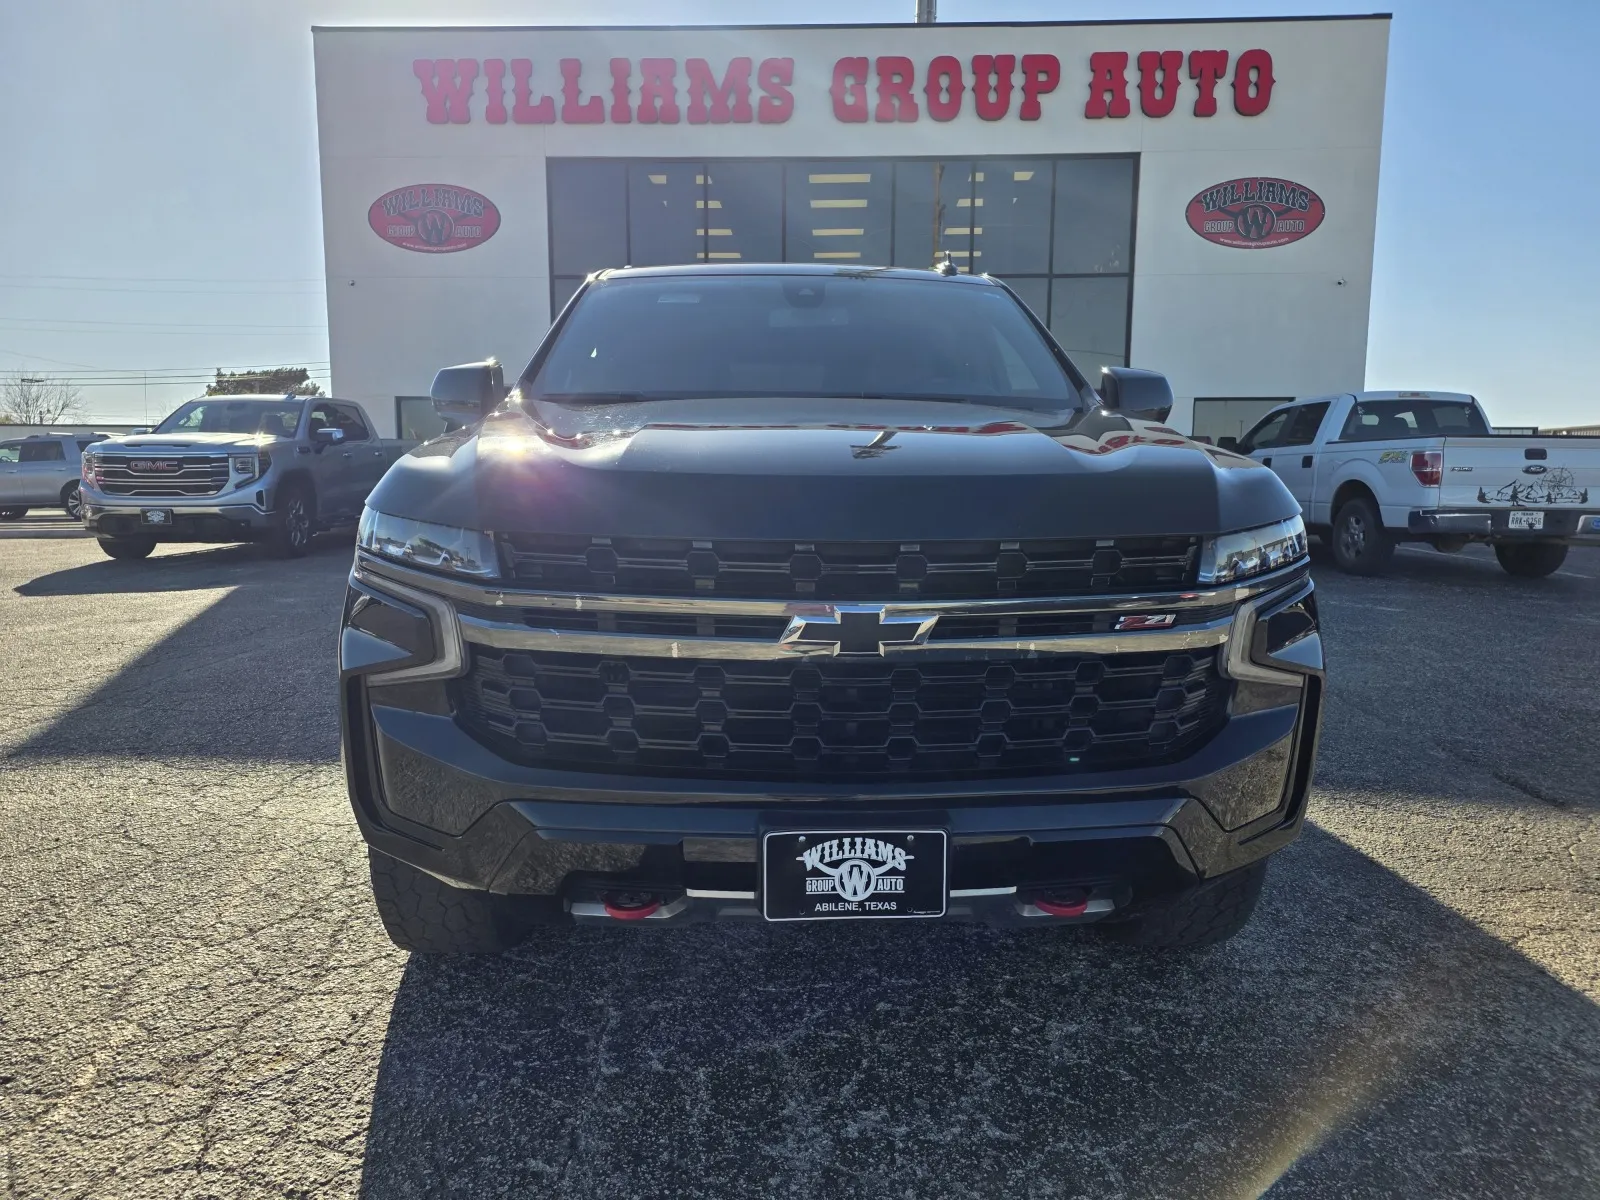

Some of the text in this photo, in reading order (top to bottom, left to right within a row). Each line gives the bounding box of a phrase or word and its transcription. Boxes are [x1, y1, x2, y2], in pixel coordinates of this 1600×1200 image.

[413, 49, 1276, 124] WILLIAMS GROUP AUTO
[382, 188, 484, 218] WILLIAMS
[1202, 180, 1310, 213] WILLIAMS
[387, 225, 481, 238] GROUP AUTO
[1204, 220, 1304, 232] GROUP AUTO
[131, 461, 178, 470] GMC
[1114, 614, 1177, 630] Z71
[803, 837, 907, 871] WILLIAMS
[806, 879, 904, 892] GROUP AUTO
[814, 902, 897, 912] ABILENE, TEXAS
